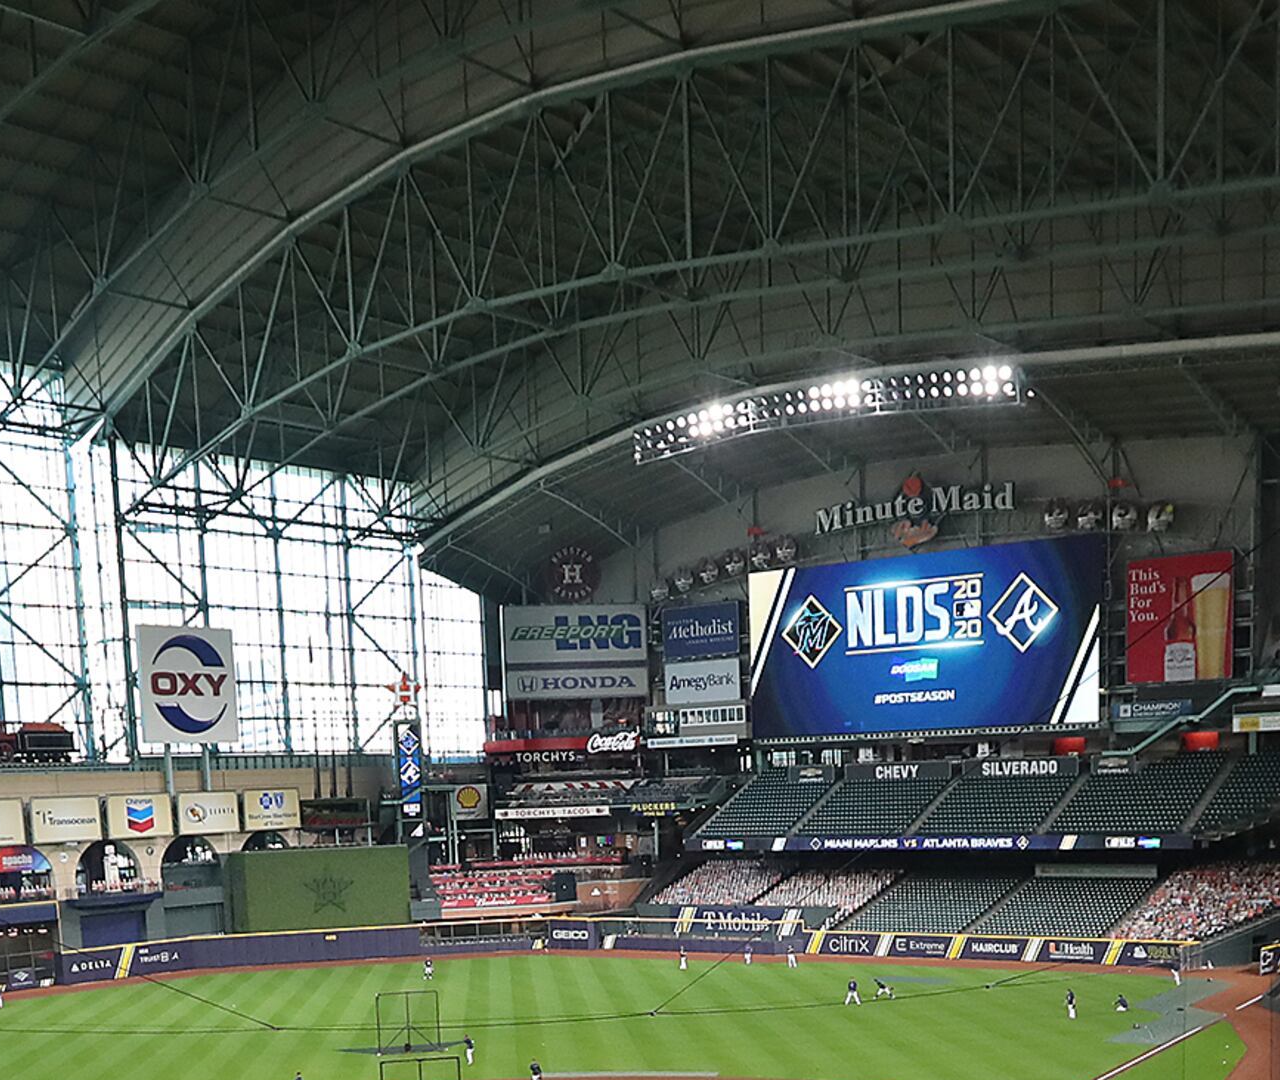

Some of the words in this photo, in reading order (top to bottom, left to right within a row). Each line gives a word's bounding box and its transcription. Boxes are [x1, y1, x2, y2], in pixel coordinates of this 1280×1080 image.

[815, 494, 924, 535] Minute
[931, 482, 1016, 512] Maid
[1129, 568, 1159, 581] This
[953, 578, 981, 599] 20
[1130, 581, 1166, 595] Bud's
[1130, 597, 1152, 609] For
[846, 581, 950, 648] NLDS
[1130, 611, 1158, 622] You.
[514, 625, 622, 640] FREEPORT
[554, 613, 642, 651] LNG
[668, 618, 735, 640] Methodist
[953, 619, 981, 639] 20
[150, 671, 228, 697] OXY
[541, 675, 636, 690] HONDA
[669, 672, 736, 691] AmegyBank
[874, 689, 956, 705] #POSTSEASON
[1132, 701, 1182, 711] CHAMPION
[516, 750, 576, 763] TORCHYS
[876, 764, 919, 779] CHEVY
[981, 759, 1058, 776] SILVERADO
[49, 816, 97, 826] Transocean
[824, 839, 853, 849] MIAMI
[854, 838, 899, 849] MARLINS
[903, 838, 917, 848] VS
[922, 837, 970, 848] ATLANTA
[970, 837, 1013, 848] BRAVES
[552, 929, 589, 940] GEICO
[828, 935, 870, 953] citrix
[909, 940, 945, 951] Extreme
[971, 942, 1019, 954] HAIRCLUB
[81, 959, 112, 971] DELTA
